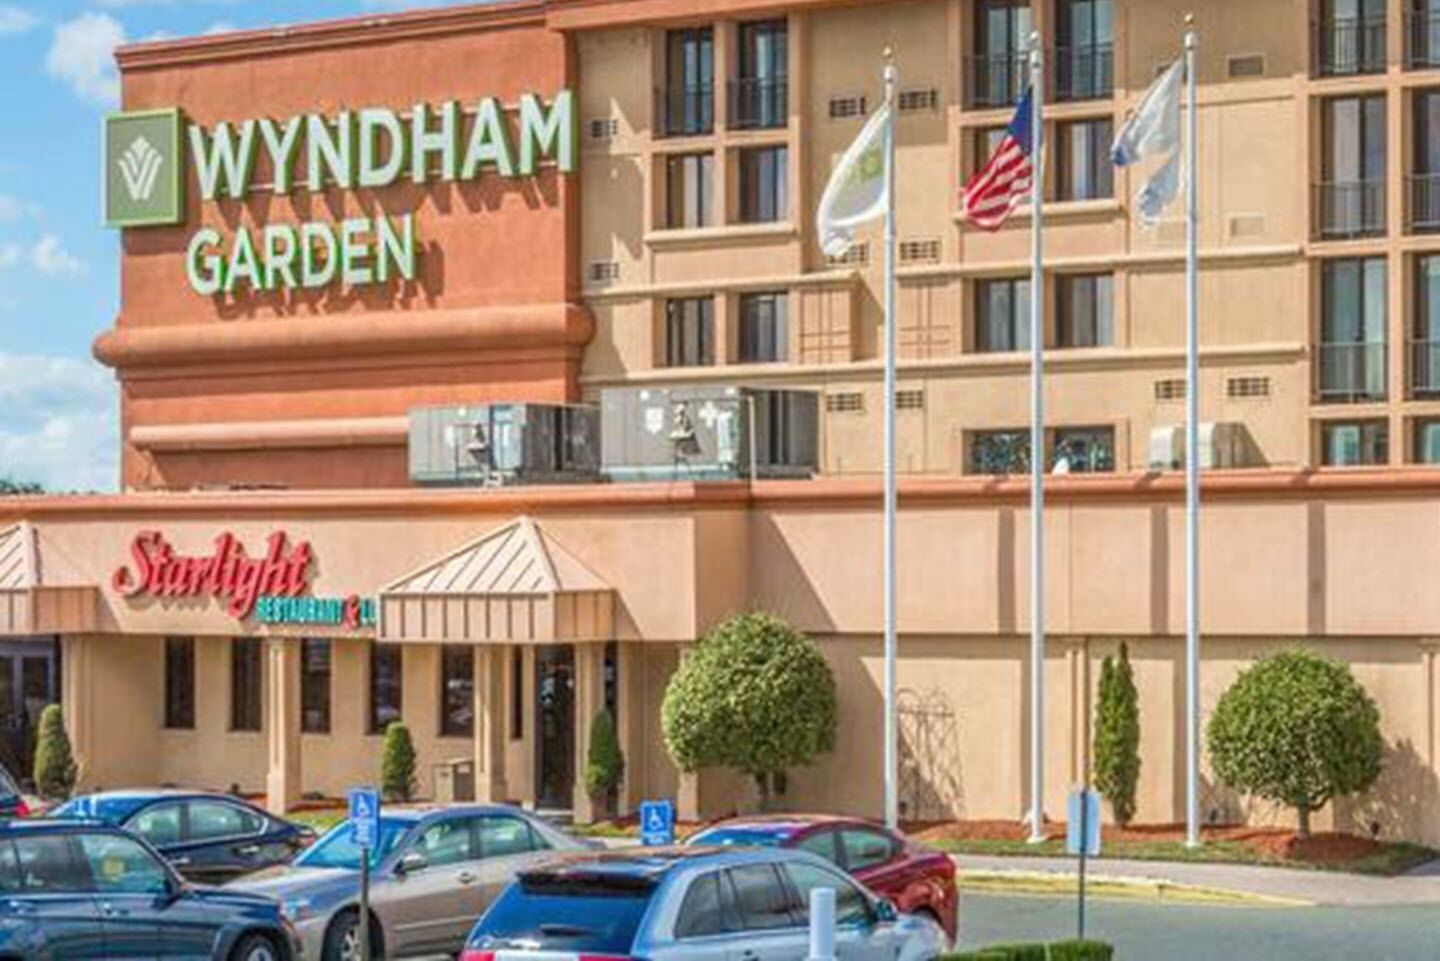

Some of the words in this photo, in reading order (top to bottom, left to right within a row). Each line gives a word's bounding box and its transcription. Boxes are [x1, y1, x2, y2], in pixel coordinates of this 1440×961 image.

[188, 90, 577, 201] WYNDHAM
[185, 213, 417, 296] GARDEN
[112, 529, 312, 619] Starlight
[256, 594, 343, 626] RESTAURANT
